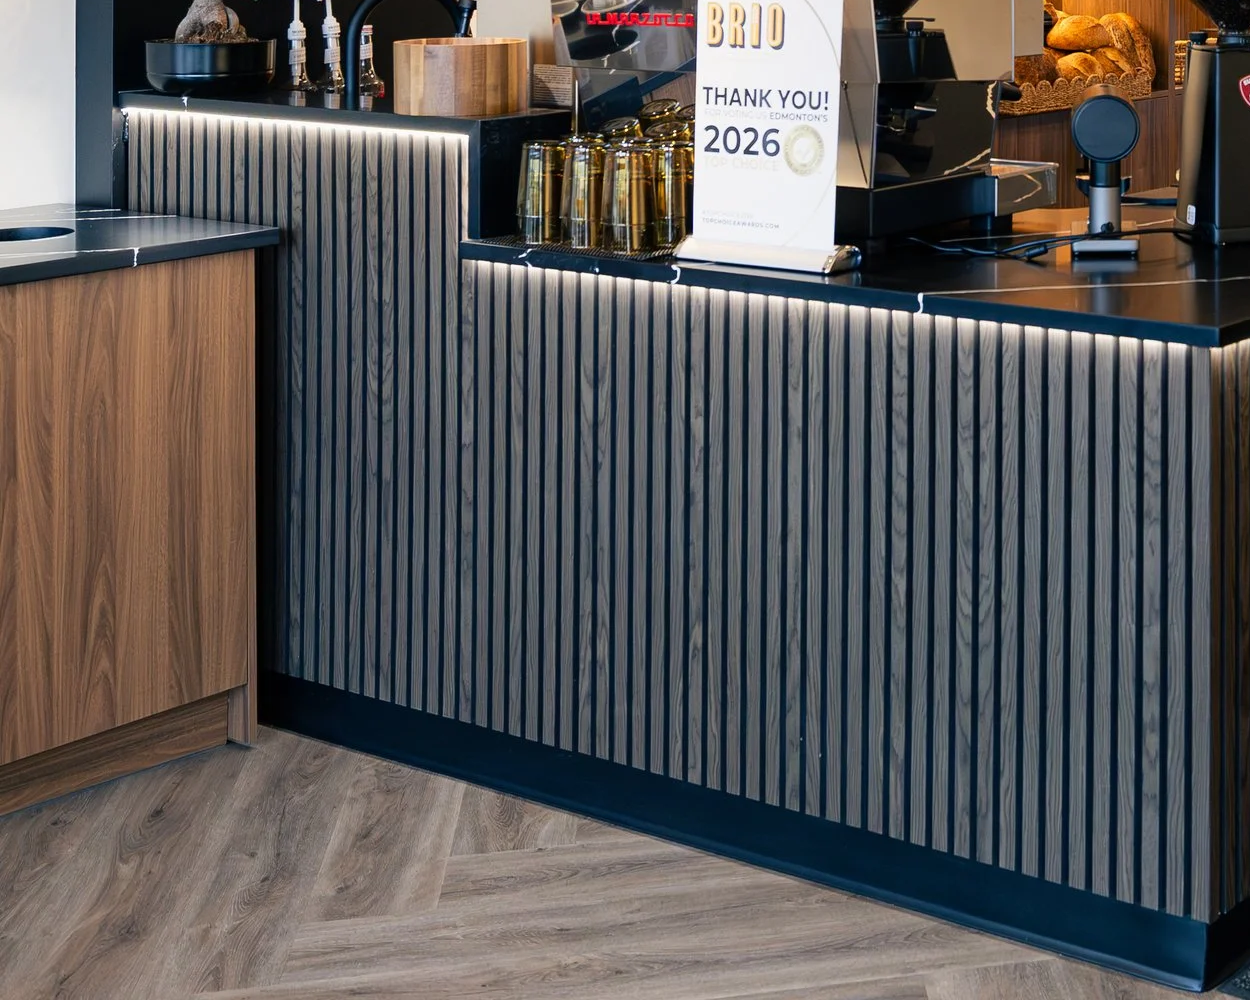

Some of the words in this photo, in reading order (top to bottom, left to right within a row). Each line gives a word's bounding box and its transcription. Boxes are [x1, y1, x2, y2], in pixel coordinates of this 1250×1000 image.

[705, 1, 785, 51] BRIO
[703, 86, 772, 109] THANK
[778, 90, 829, 112] YOU!
[704, 108, 721, 116] FOR
[723, 109, 754, 119] VOTING
[769, 111, 829, 122] EDMONTON'S
[704, 124, 780, 157] 2026
[703, 155, 728, 168] TOP
[732, 157, 780, 172] CHOICE
